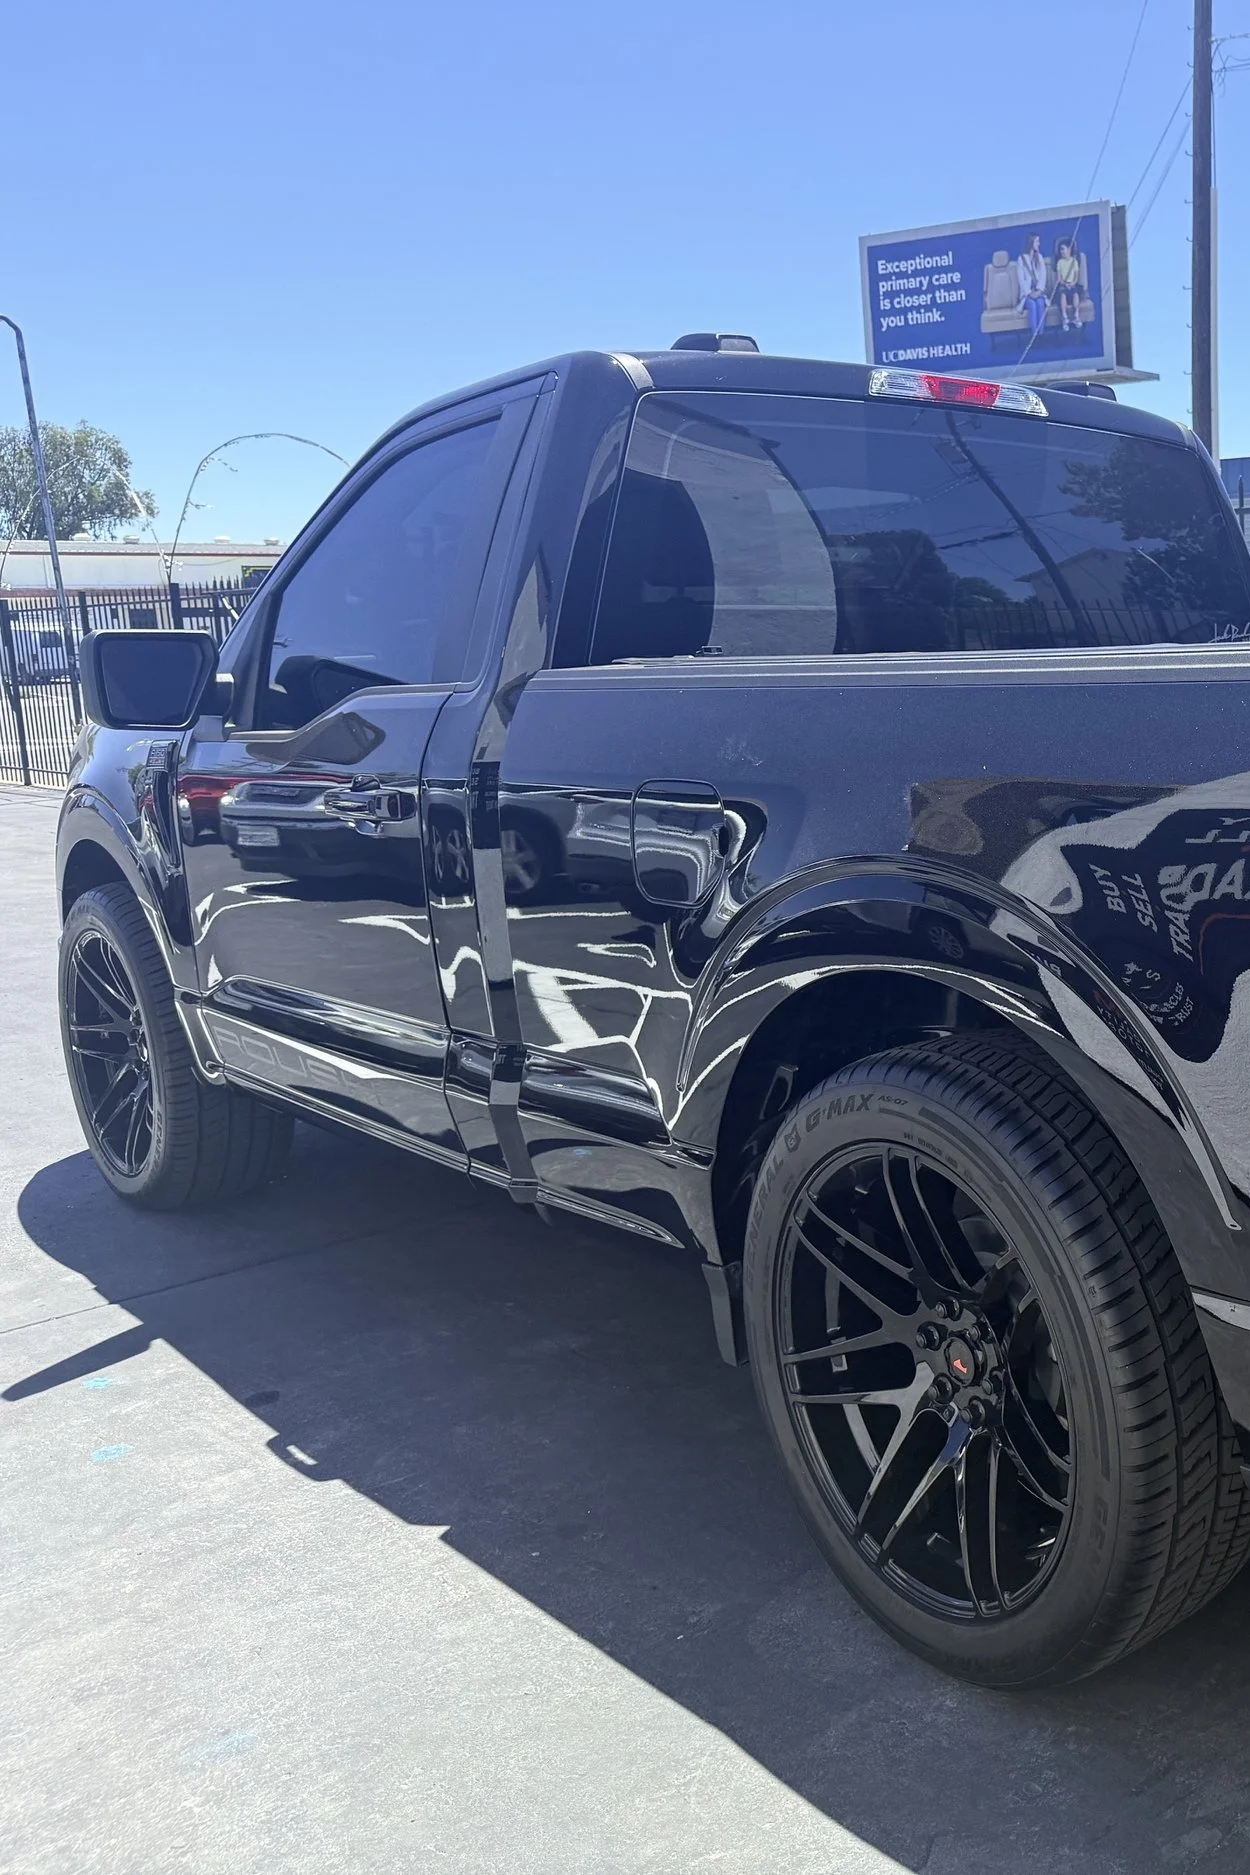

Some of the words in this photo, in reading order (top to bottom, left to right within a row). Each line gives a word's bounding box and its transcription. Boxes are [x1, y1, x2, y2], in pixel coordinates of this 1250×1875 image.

[877, 251, 953, 274] Exceptional
[879, 276, 929, 295] primary
[932, 272, 961, 285] care
[880, 296, 891, 310] is
[894, 294, 932, 308] closer
[935, 289, 966, 303] than
[880, 315, 905, 332] you
[907, 308, 945, 325] think.
[929, 342, 971, 358] HEALTH
